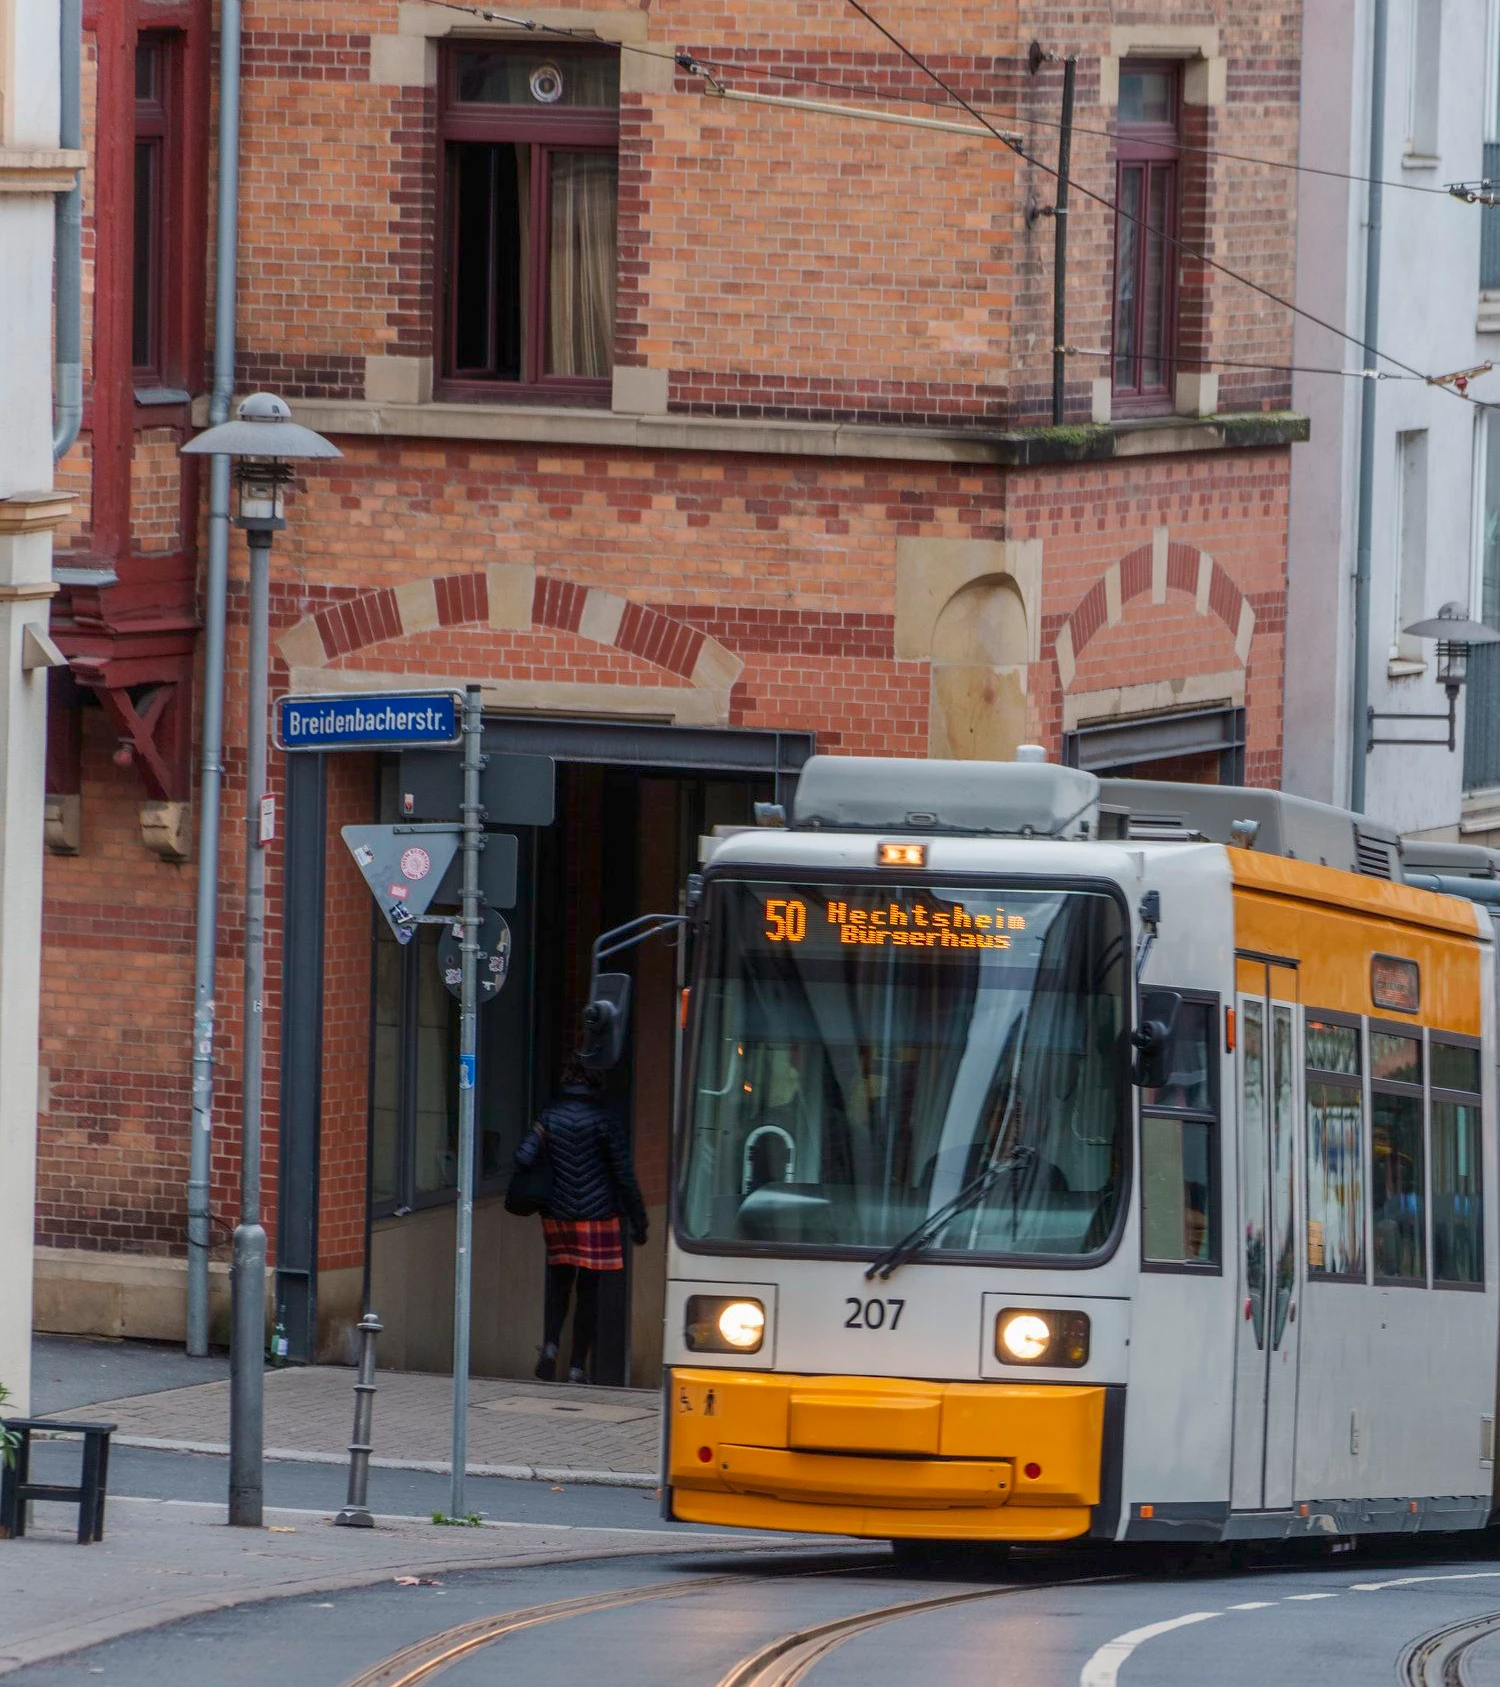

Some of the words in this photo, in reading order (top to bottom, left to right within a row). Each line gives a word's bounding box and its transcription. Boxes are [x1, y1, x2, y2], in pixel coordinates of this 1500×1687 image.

[289, 707, 447, 736] Breidenbacherstr.
[766, 899, 806, 942] 50
[827, 901, 1026, 930] Hechtsheim
[841, 924, 1012, 949] Bürgerhaus
[844, 1297, 905, 1330] 207
